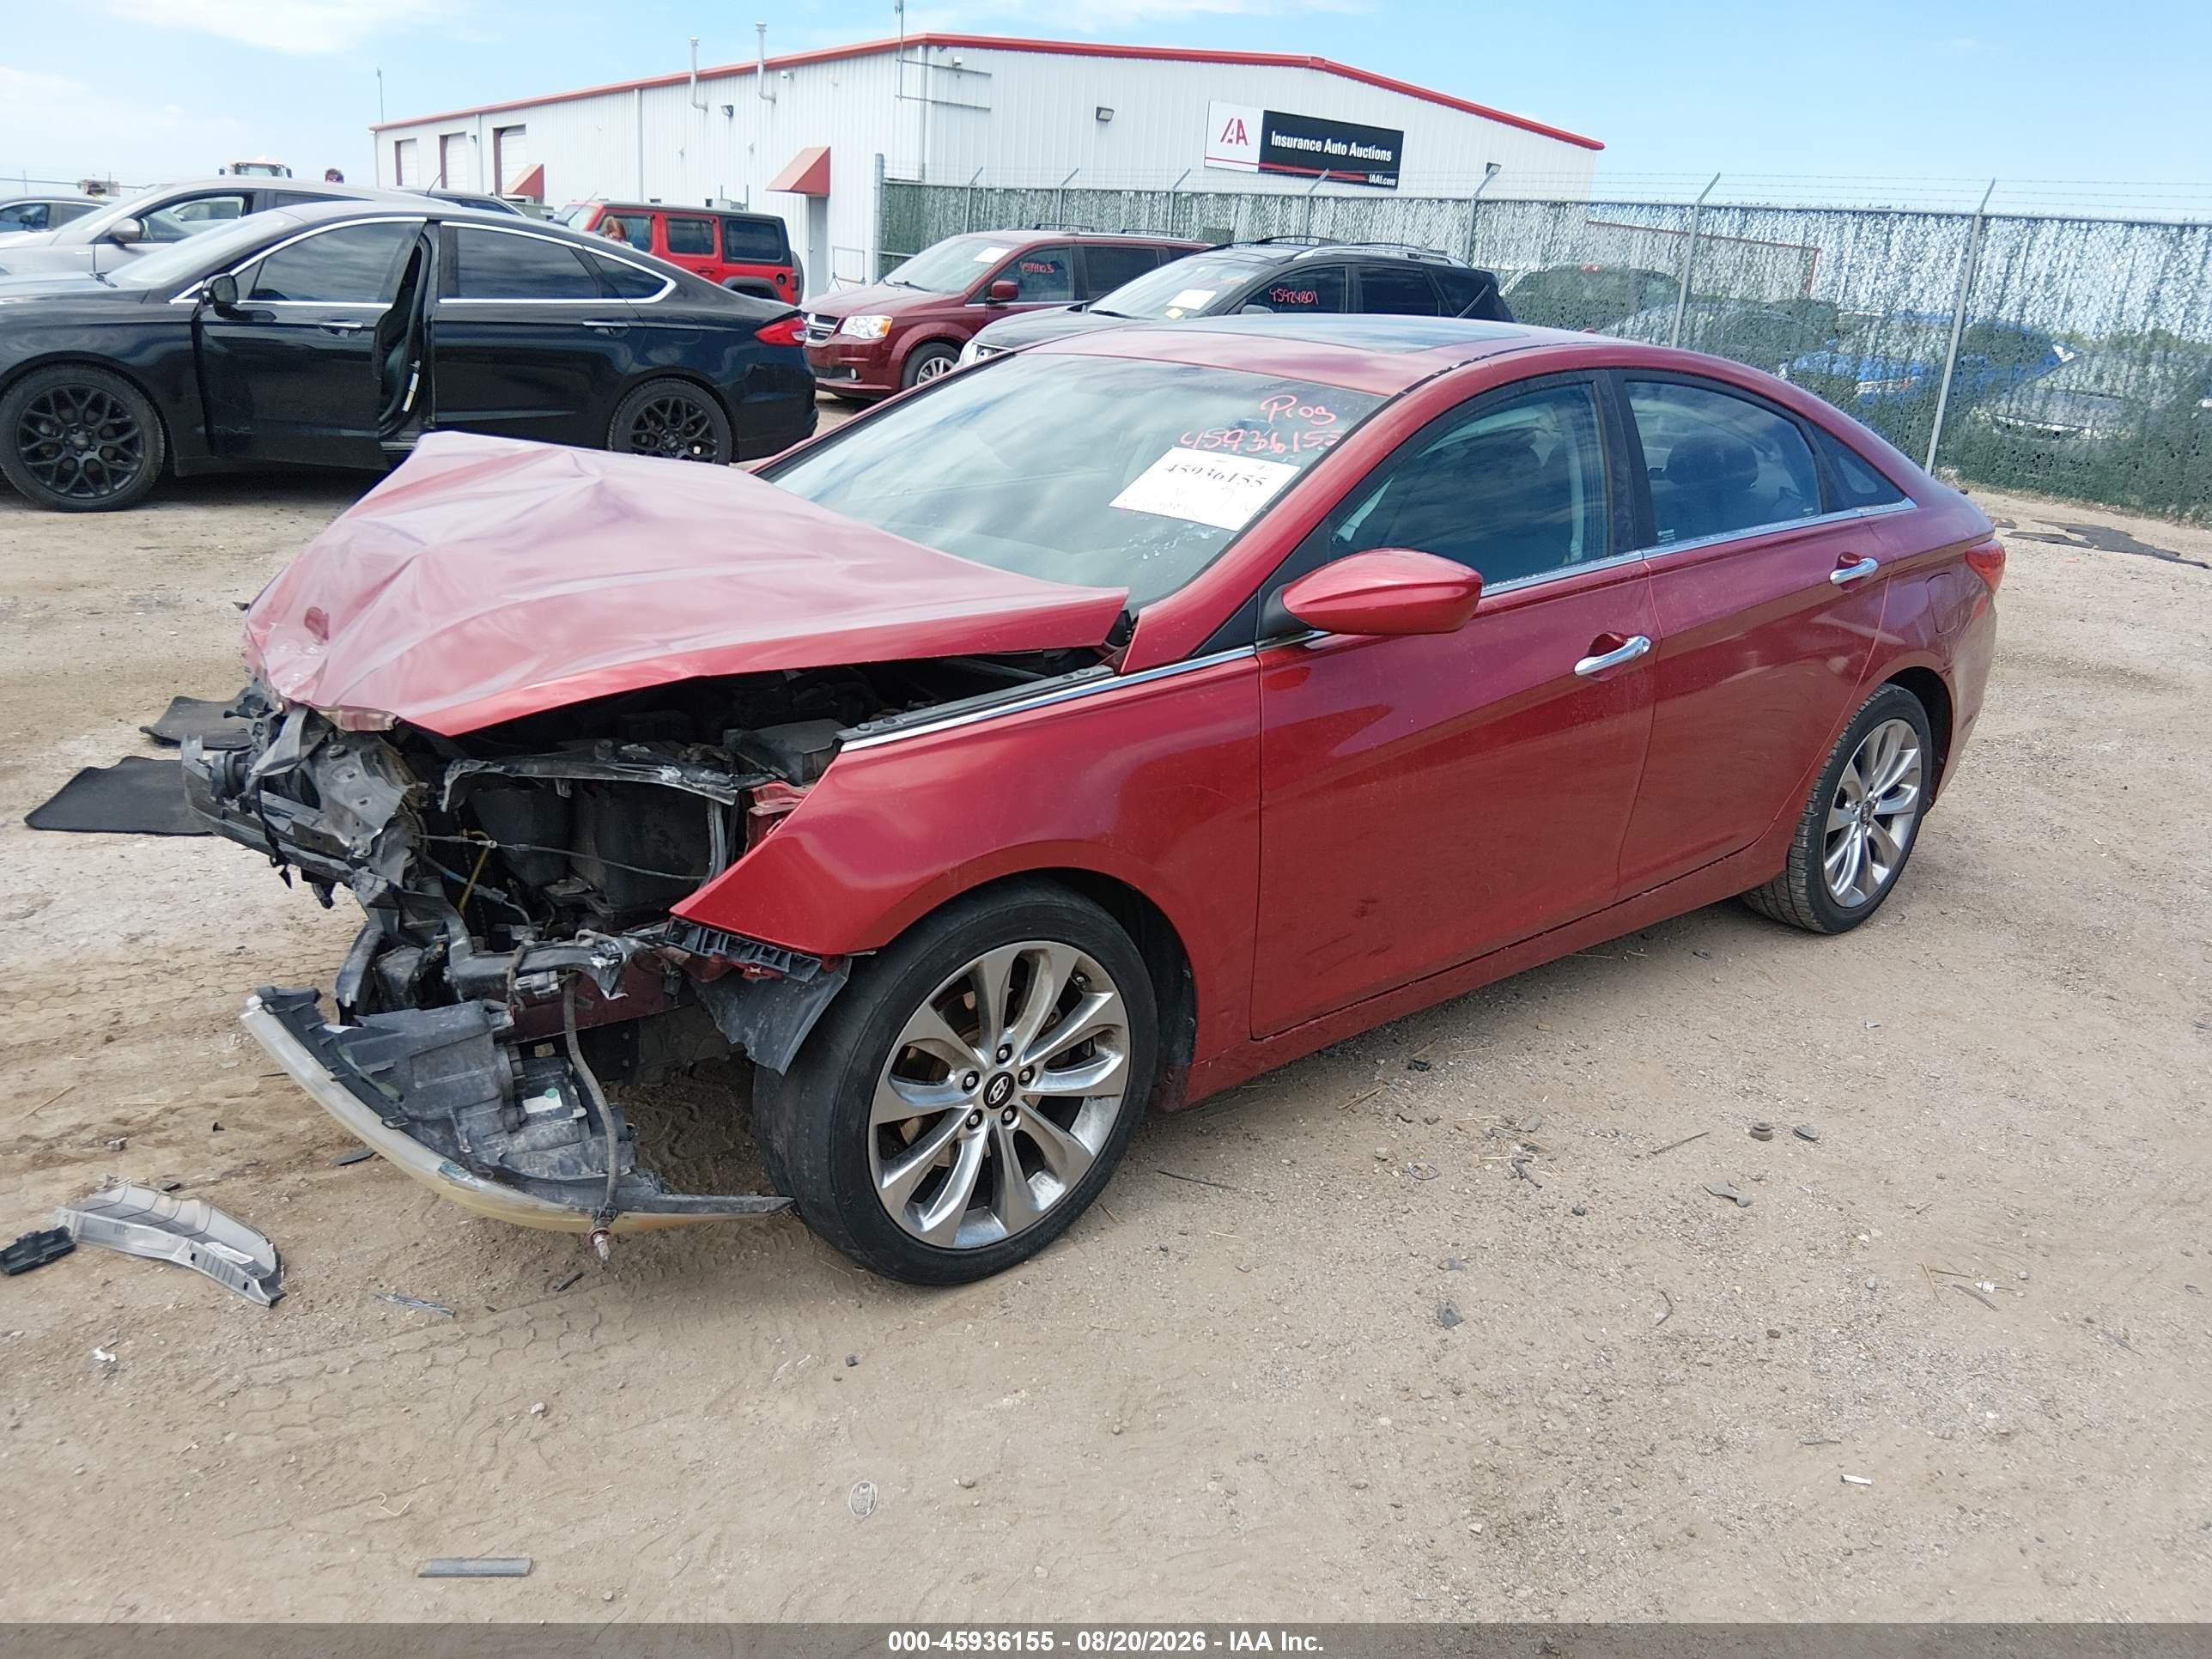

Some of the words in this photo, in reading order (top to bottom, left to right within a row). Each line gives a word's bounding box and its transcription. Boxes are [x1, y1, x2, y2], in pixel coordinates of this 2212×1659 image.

[1271, 131, 1322, 152] Insurance
[1323, 138, 1347, 155] Auto
[1348, 142, 1392, 162] Auctions
